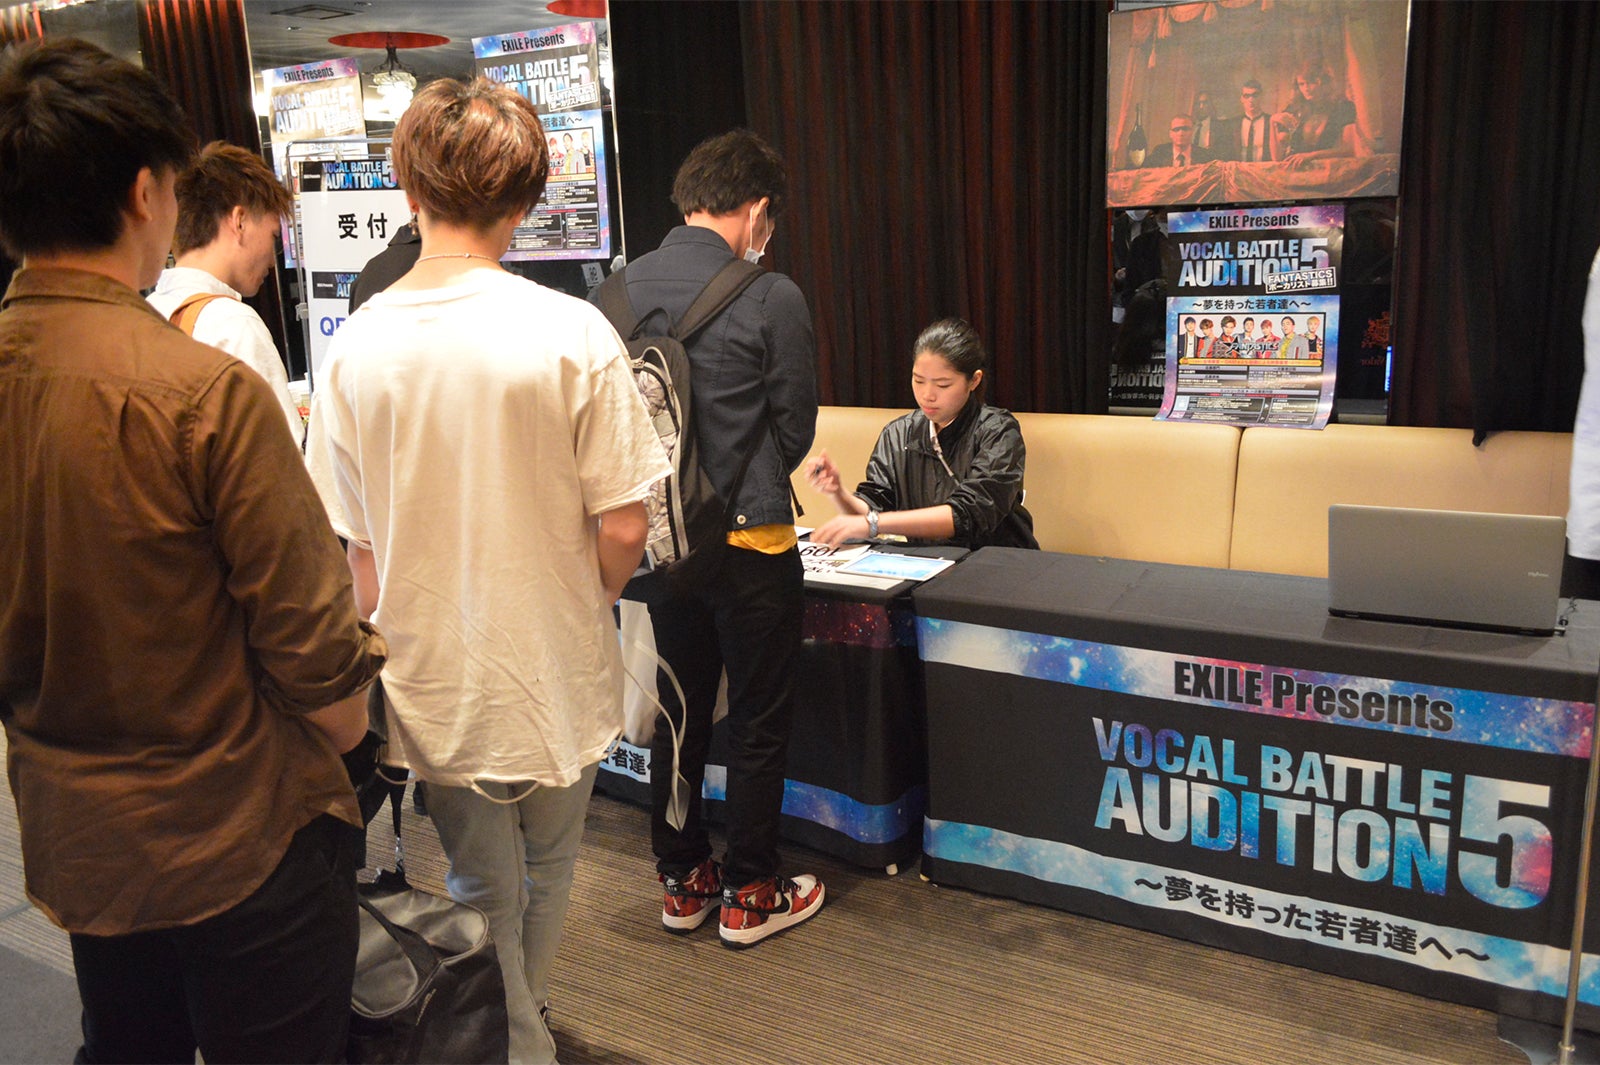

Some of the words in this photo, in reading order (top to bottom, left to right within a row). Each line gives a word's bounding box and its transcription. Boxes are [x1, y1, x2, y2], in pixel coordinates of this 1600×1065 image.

[501, 38, 523, 52] EXILE
[525, 33, 565, 49] Presents
[283, 71, 302, 83] EXILE
[301, 66, 334, 81] Presents
[484, 62, 524, 82] VOCAL
[525, 57, 570, 78] BATTLE
[569, 54, 590, 85] 5
[271, 92, 303, 110] VOCAL
[322, 162, 350, 173] VOCAL
[351, 161, 381, 172] BATTLE
[325, 172, 382, 189] AUDITION
[381, 161, 397, 188] 5
[1209, 215, 1239, 229] EXILE
[1242, 213, 1299, 228] Presents
[1179, 241, 1234, 260] VOCAL
[1237, 239, 1299, 258] BATTLE
[1178, 258, 1299, 287] AUDITION
[1299, 238, 1330, 271] 5
[1268, 269, 1333, 284] FANTASTICS
[1174, 660, 1263, 707] EXILE
[1271, 673, 1455, 733] Presents
[1092, 716, 1250, 786] VOCAL
[1260, 745, 1453, 820] BATTLE
[1094, 767, 1451, 897] AUDITION
[1456, 775, 1553, 910] 5
